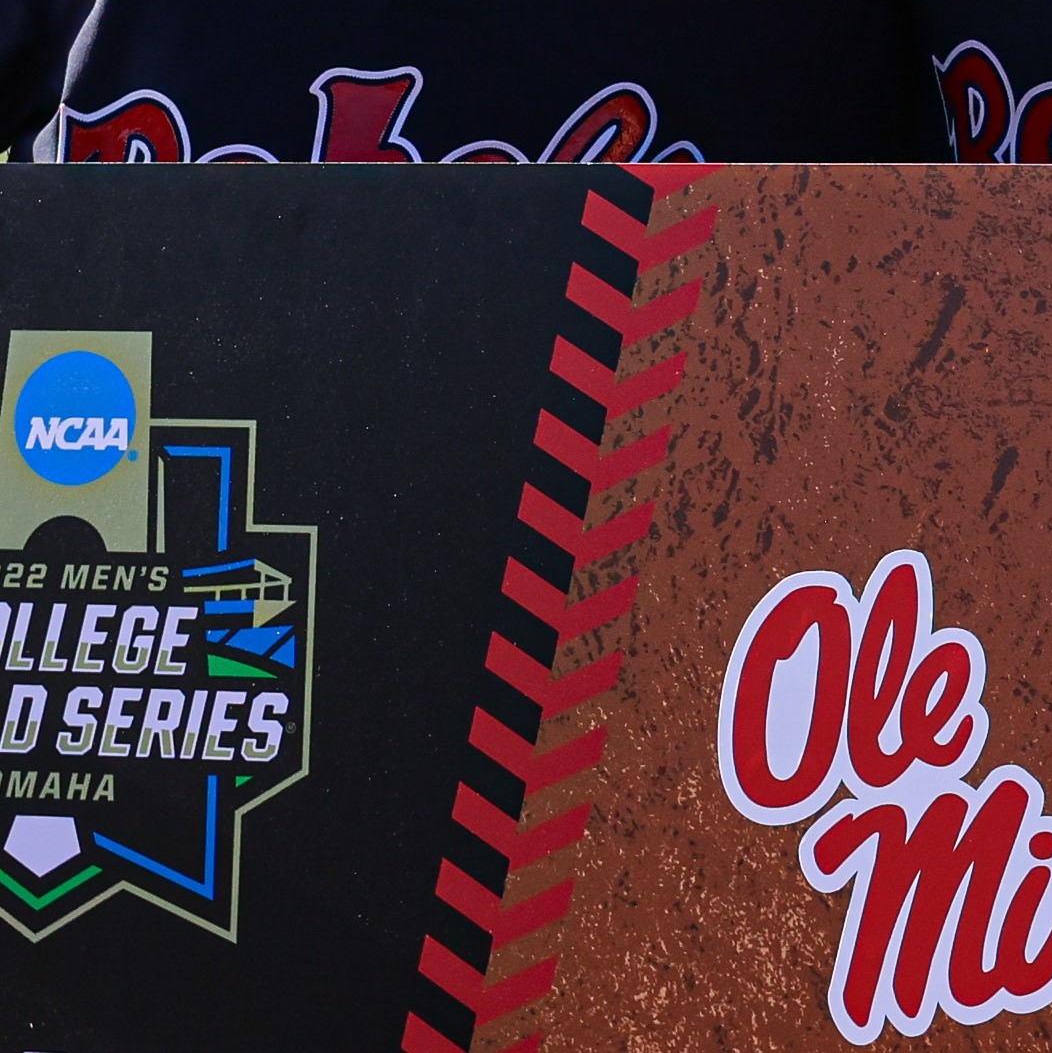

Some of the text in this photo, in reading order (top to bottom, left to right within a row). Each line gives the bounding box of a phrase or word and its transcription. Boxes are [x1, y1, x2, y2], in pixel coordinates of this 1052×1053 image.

[25, 416, 129, 451] NCAA
[0, 562, 169, 592] 22 MEN'S
[0, 601, 200, 676] LLEGE
[724, 554, 985, 820] Ole
[55, 685, 290, 763] SERIES
[0, 770, 116, 803] MAHA
